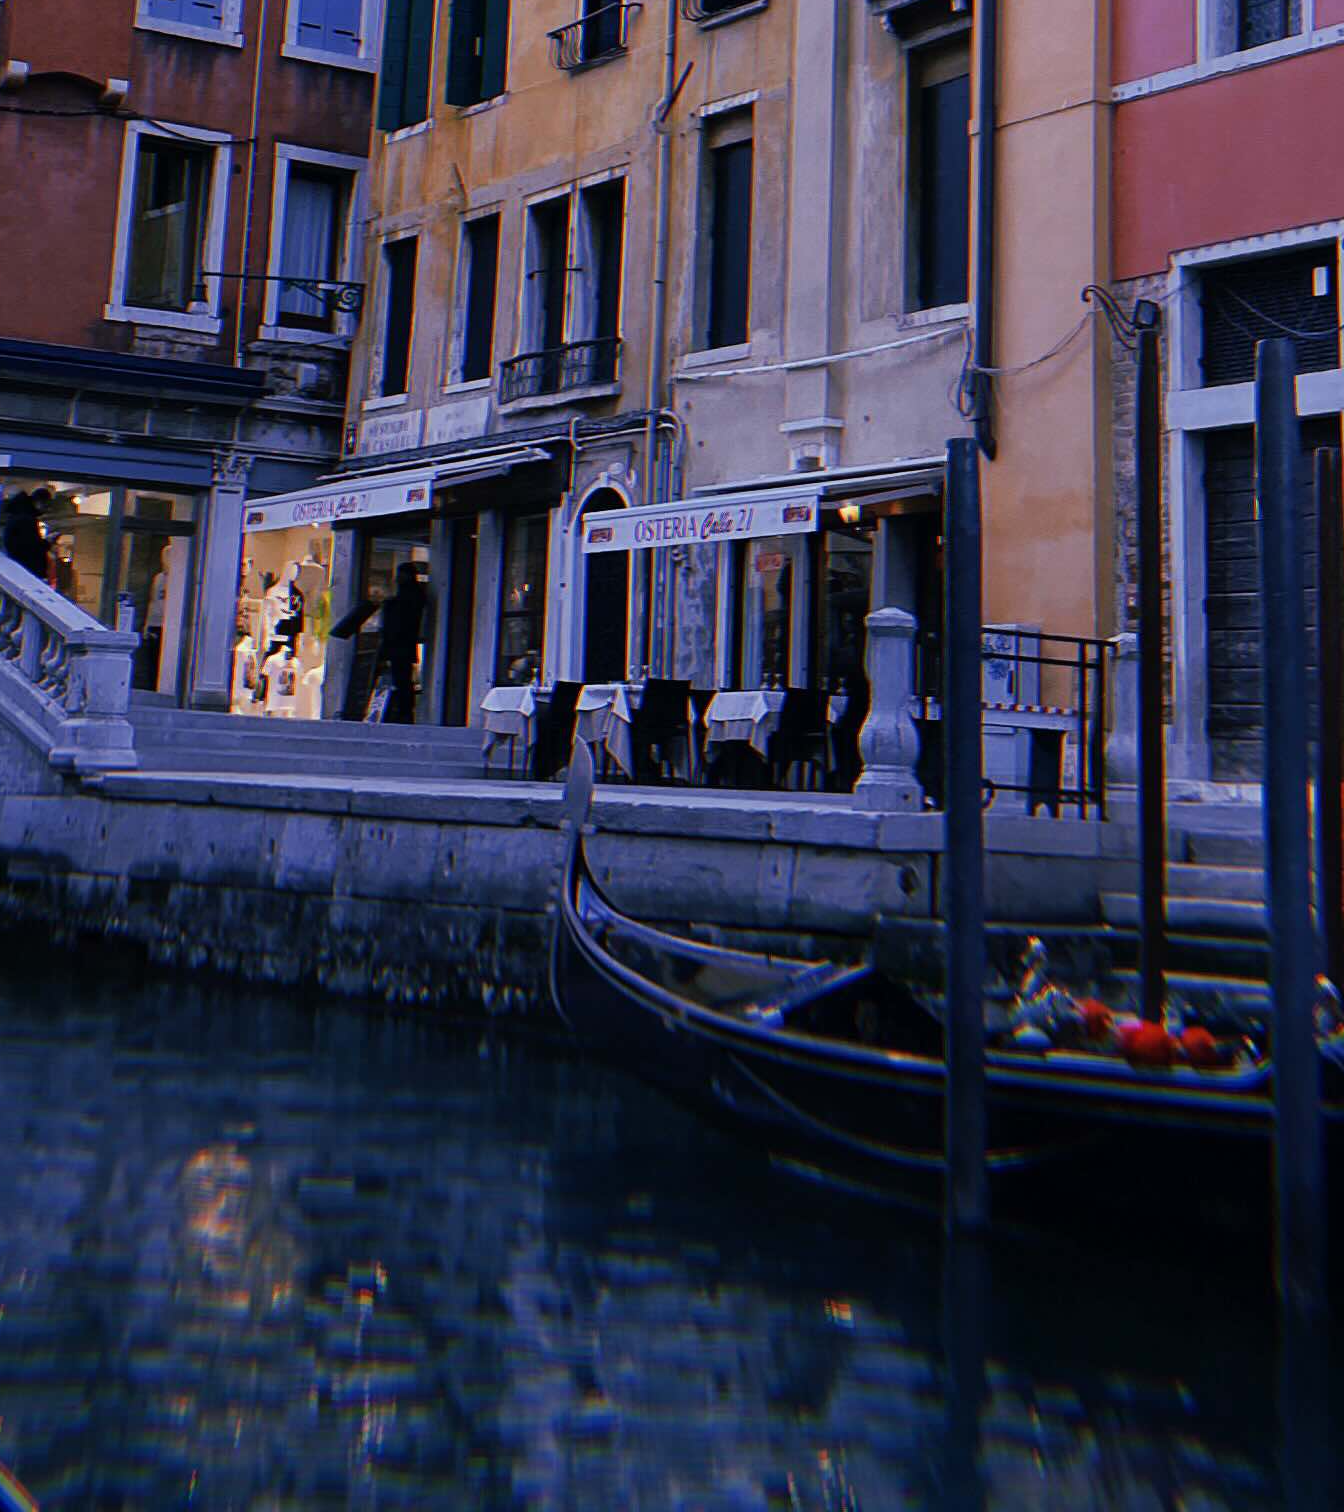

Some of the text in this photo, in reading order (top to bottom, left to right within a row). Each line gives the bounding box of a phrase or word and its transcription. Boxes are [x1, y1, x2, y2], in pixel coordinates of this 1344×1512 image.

[292, 498, 334, 522] OSTERIA
[634, 514, 697, 543] OSTERIA
[736, 508, 754, 532] 21
